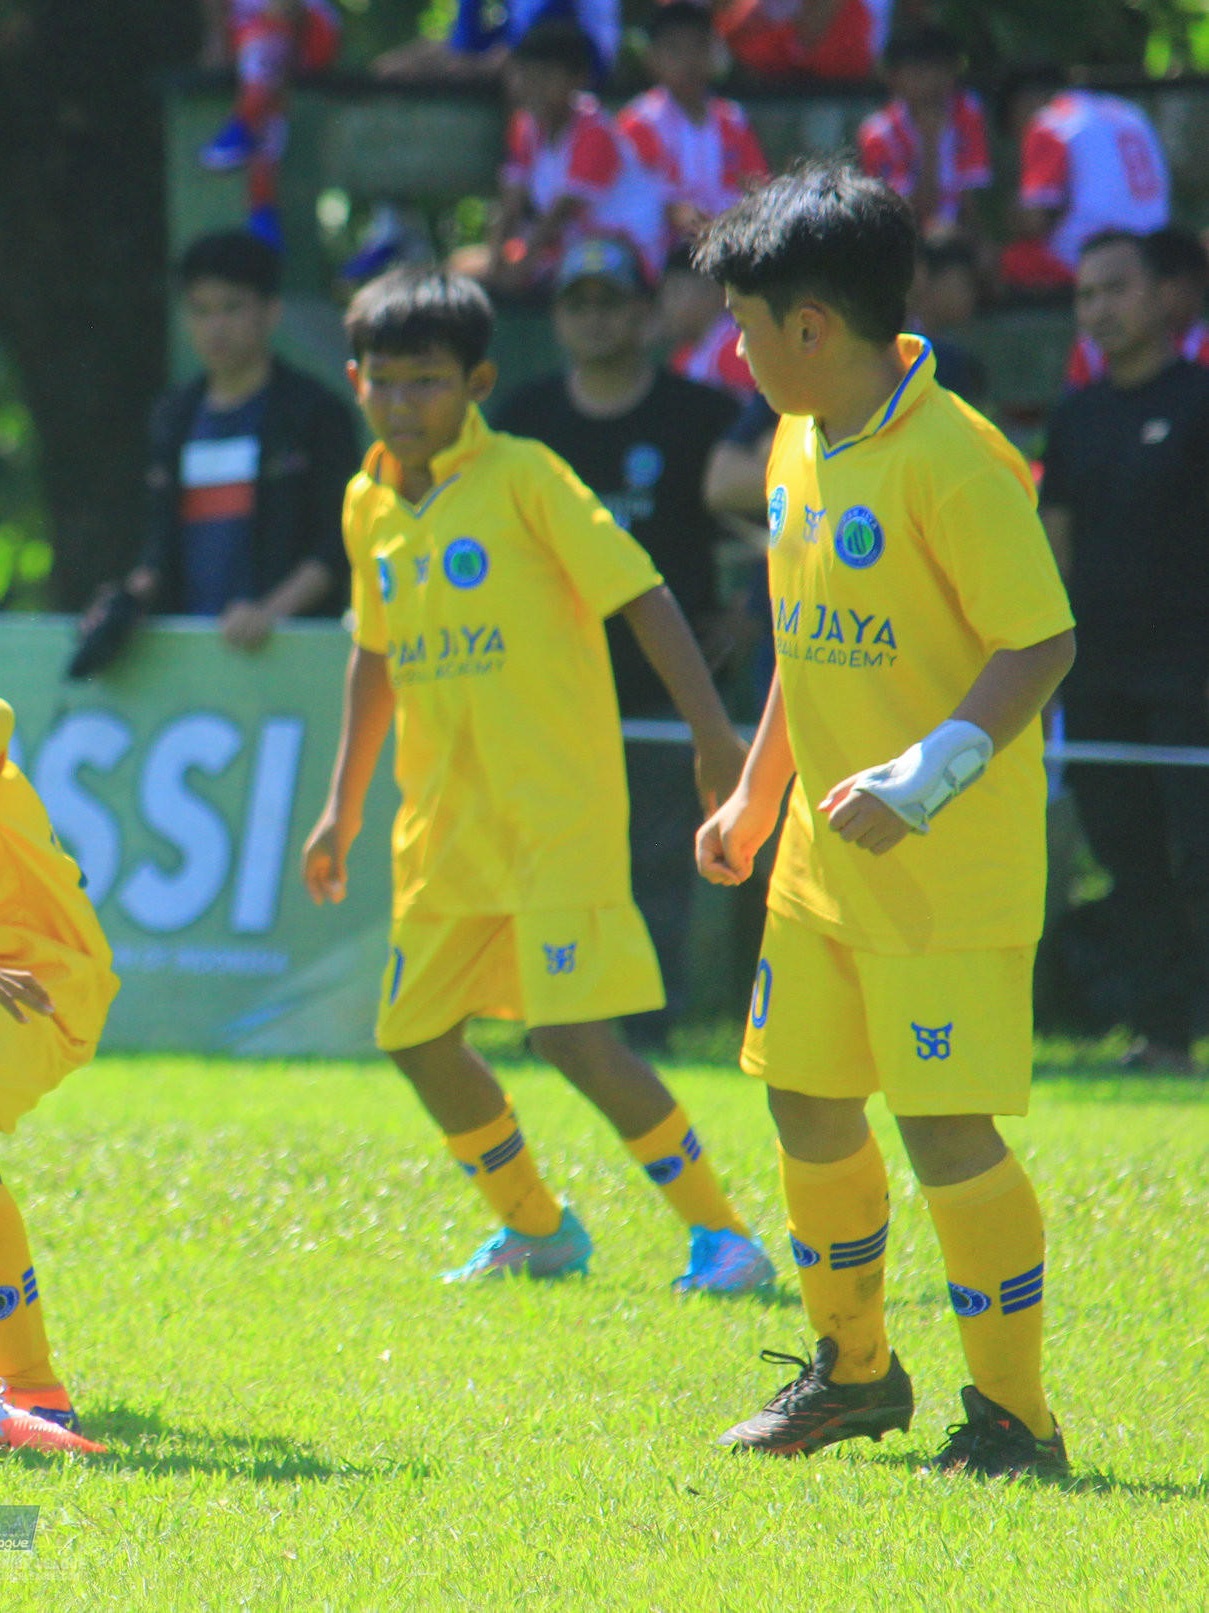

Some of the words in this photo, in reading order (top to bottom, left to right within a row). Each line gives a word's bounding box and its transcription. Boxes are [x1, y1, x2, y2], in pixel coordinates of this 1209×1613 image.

[810, 604, 898, 650] JAYA
[804, 645, 898, 668] ACADEMY
[12, 711, 304, 934] SSI
